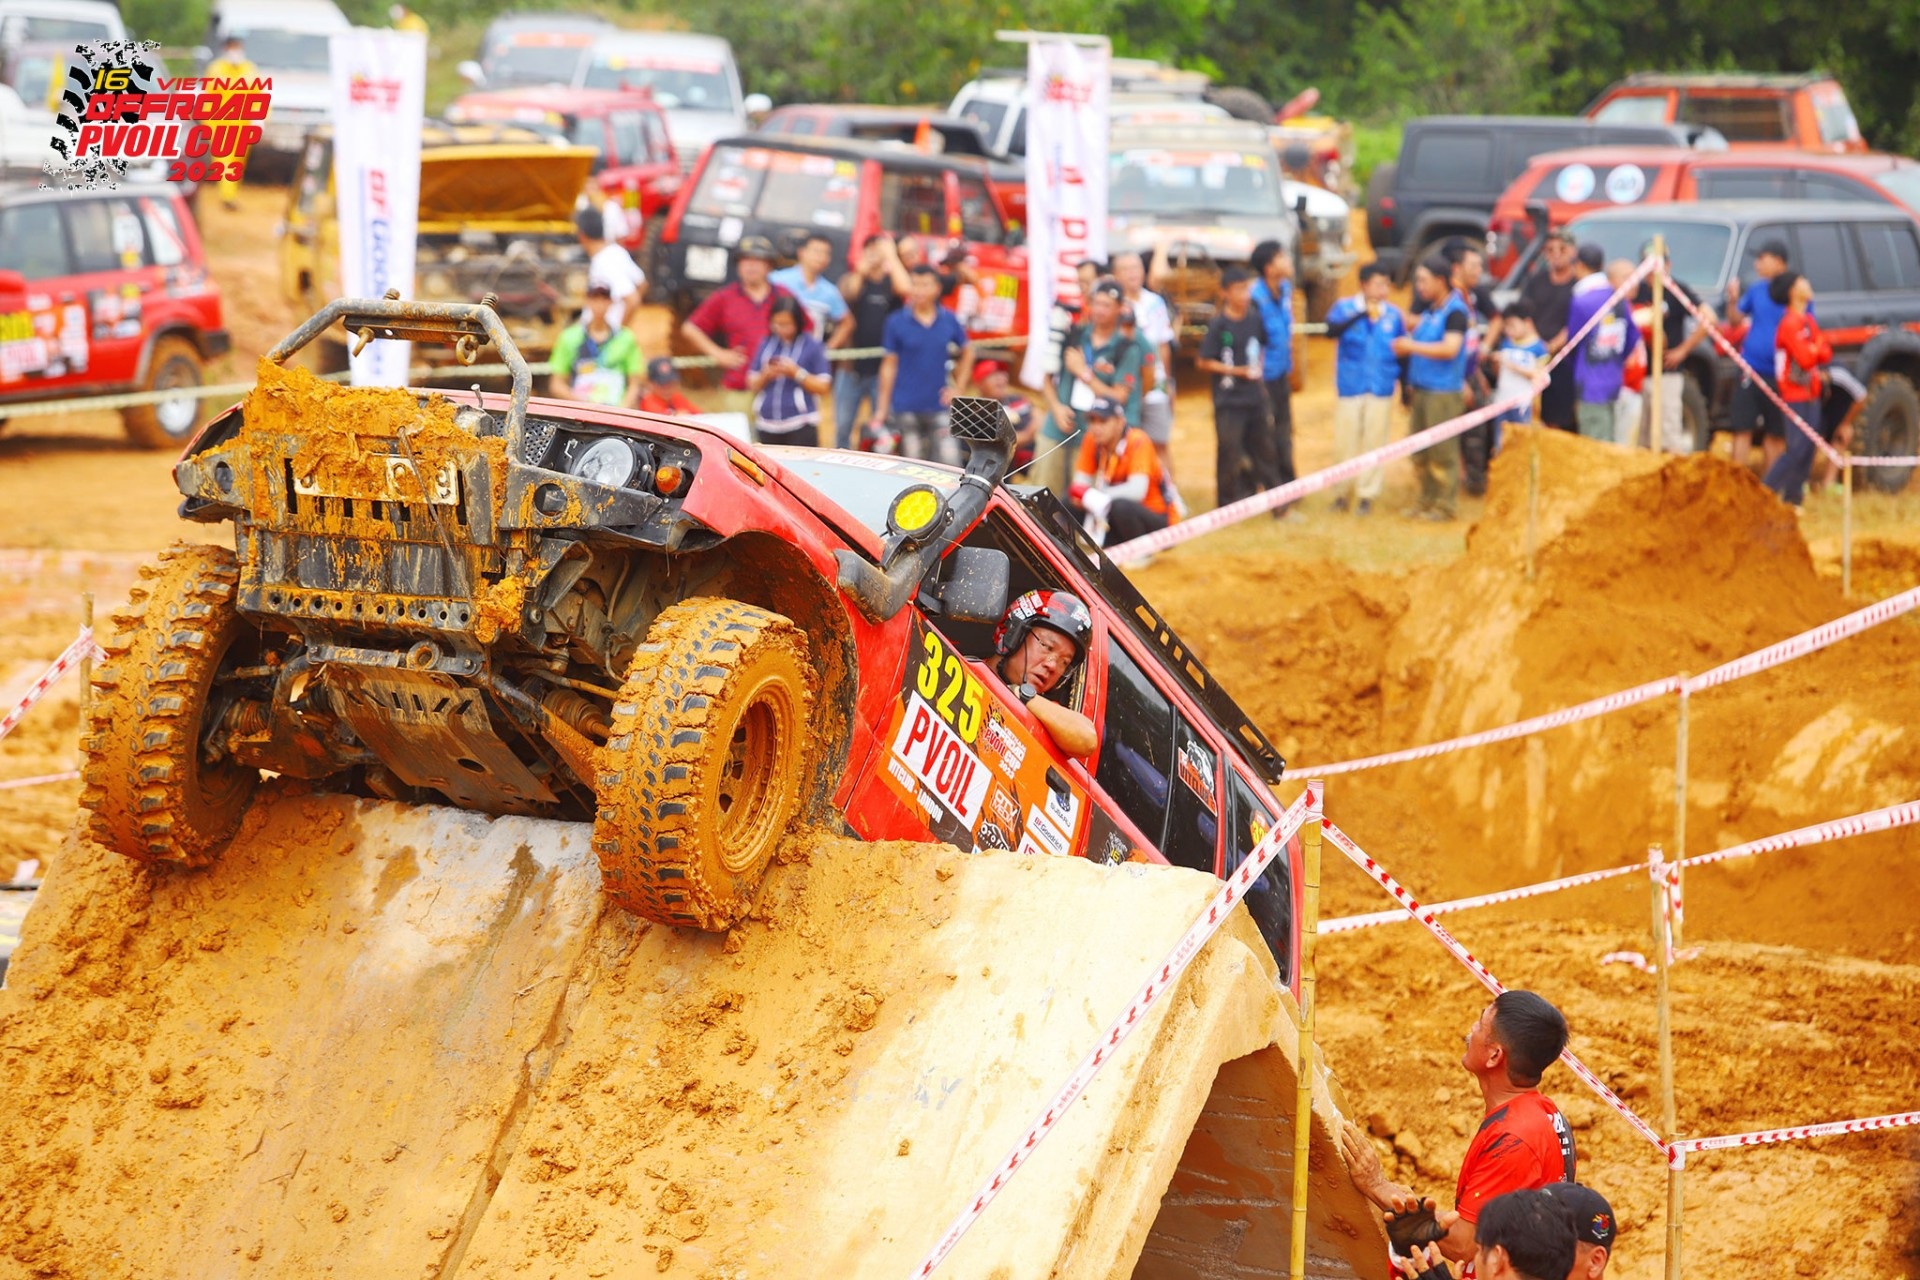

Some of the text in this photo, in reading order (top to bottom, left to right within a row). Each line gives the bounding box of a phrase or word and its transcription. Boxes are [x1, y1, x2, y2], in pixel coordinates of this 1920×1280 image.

[916, 631, 984, 744] 325
[903, 704, 977, 818] PVOIL
[984, 729, 1022, 772] PVOIL CUP
[916, 788, 944, 824] LONDON
[1050, 802, 1071, 828] SUBARU
